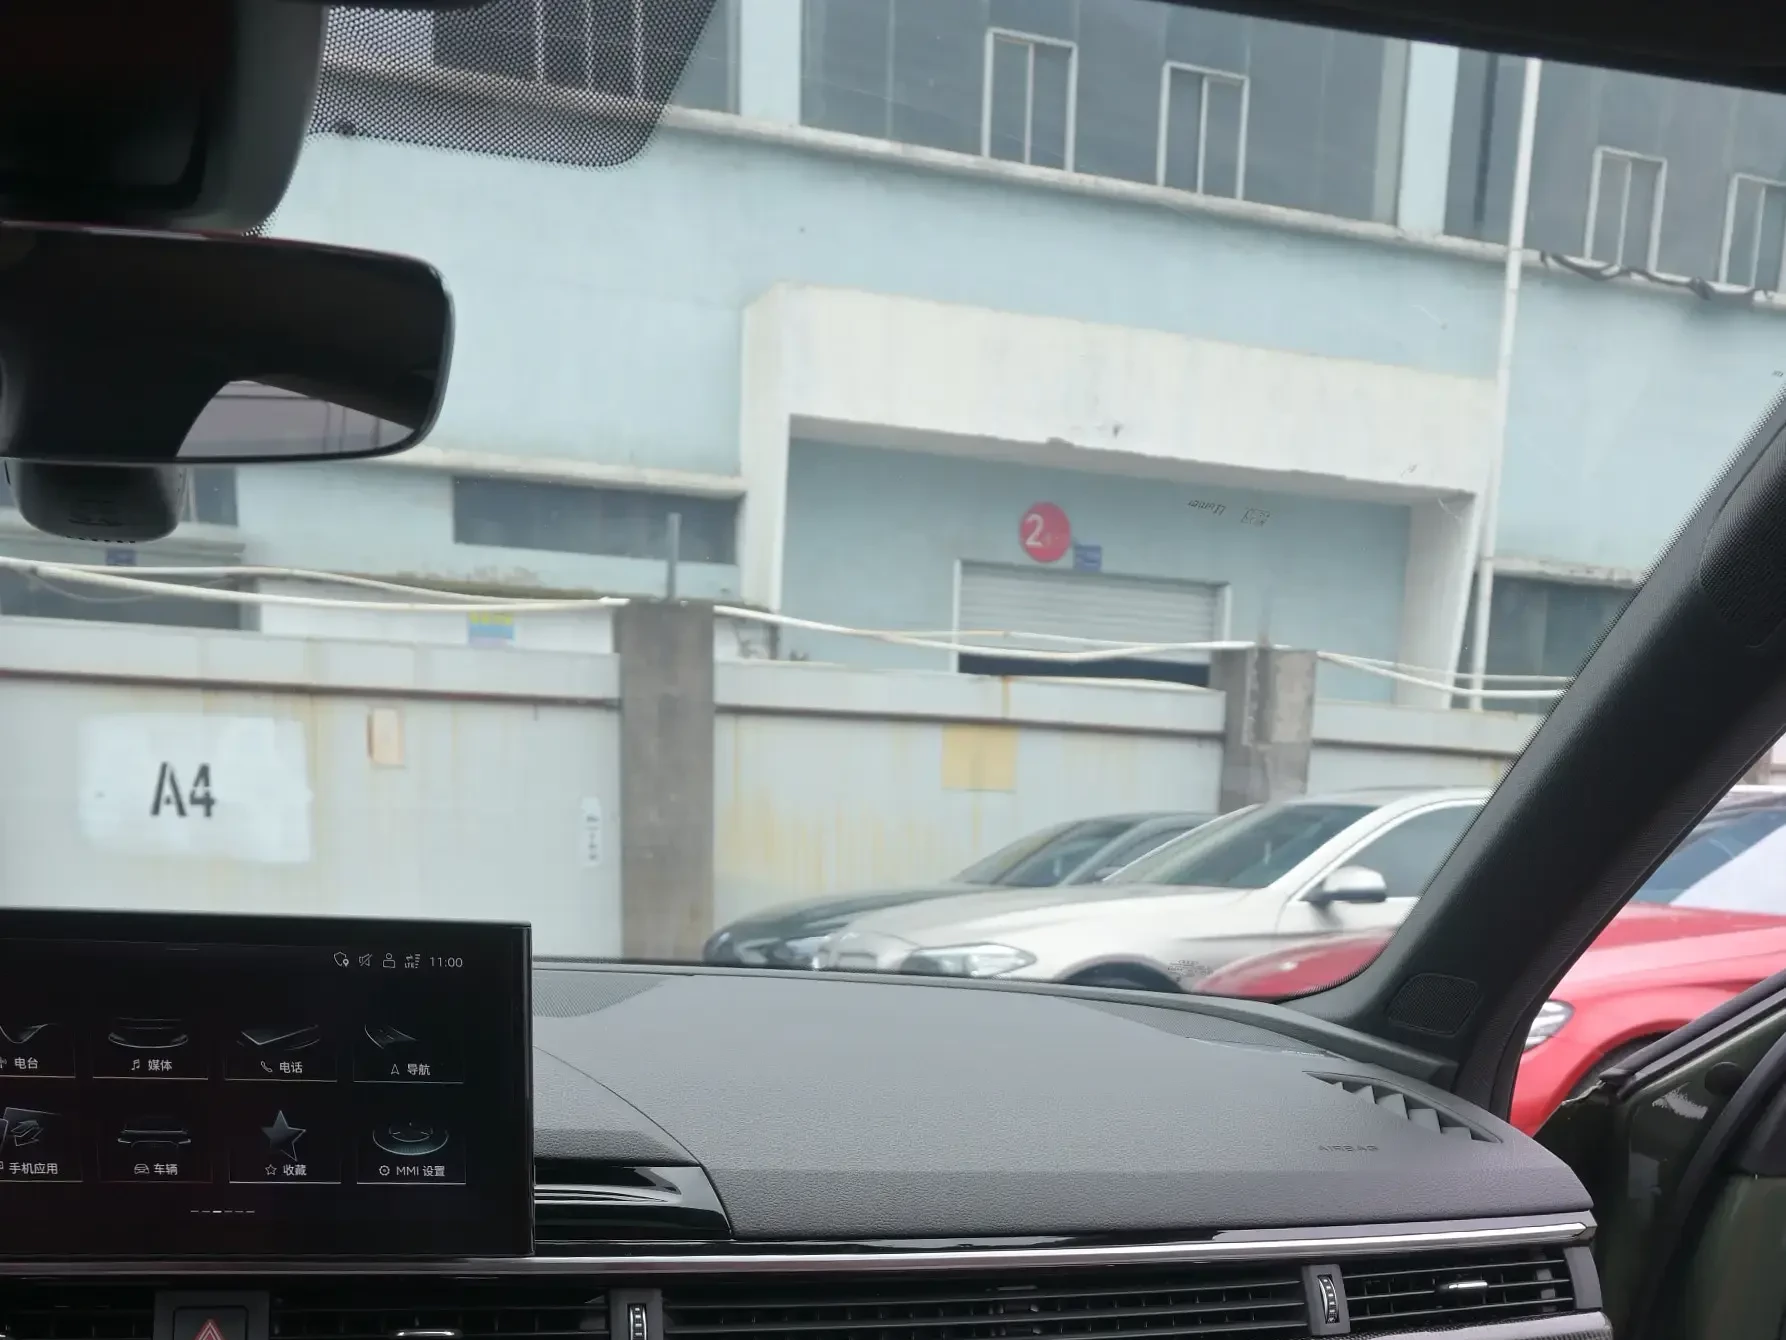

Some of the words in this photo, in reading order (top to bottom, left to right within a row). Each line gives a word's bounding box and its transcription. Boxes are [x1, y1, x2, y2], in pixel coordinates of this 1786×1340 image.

[150, 761, 216, 818] A4
[429, 956, 463, 967] 11:00
[14, 1057, 39, 1070] 电台
[147, 1059, 173, 1072] 媒体
[279, 1061, 303, 1074] 电话
[407, 1063, 431, 1076] 导航
[9, 1162, 58, 1175] 手机应用
[153, 1163, 178, 1176] 车辆
[283, 1164, 307, 1177] 收藏
[396, 1166, 419, 1176] MMI
[422, 1165, 446, 1177] 设置
